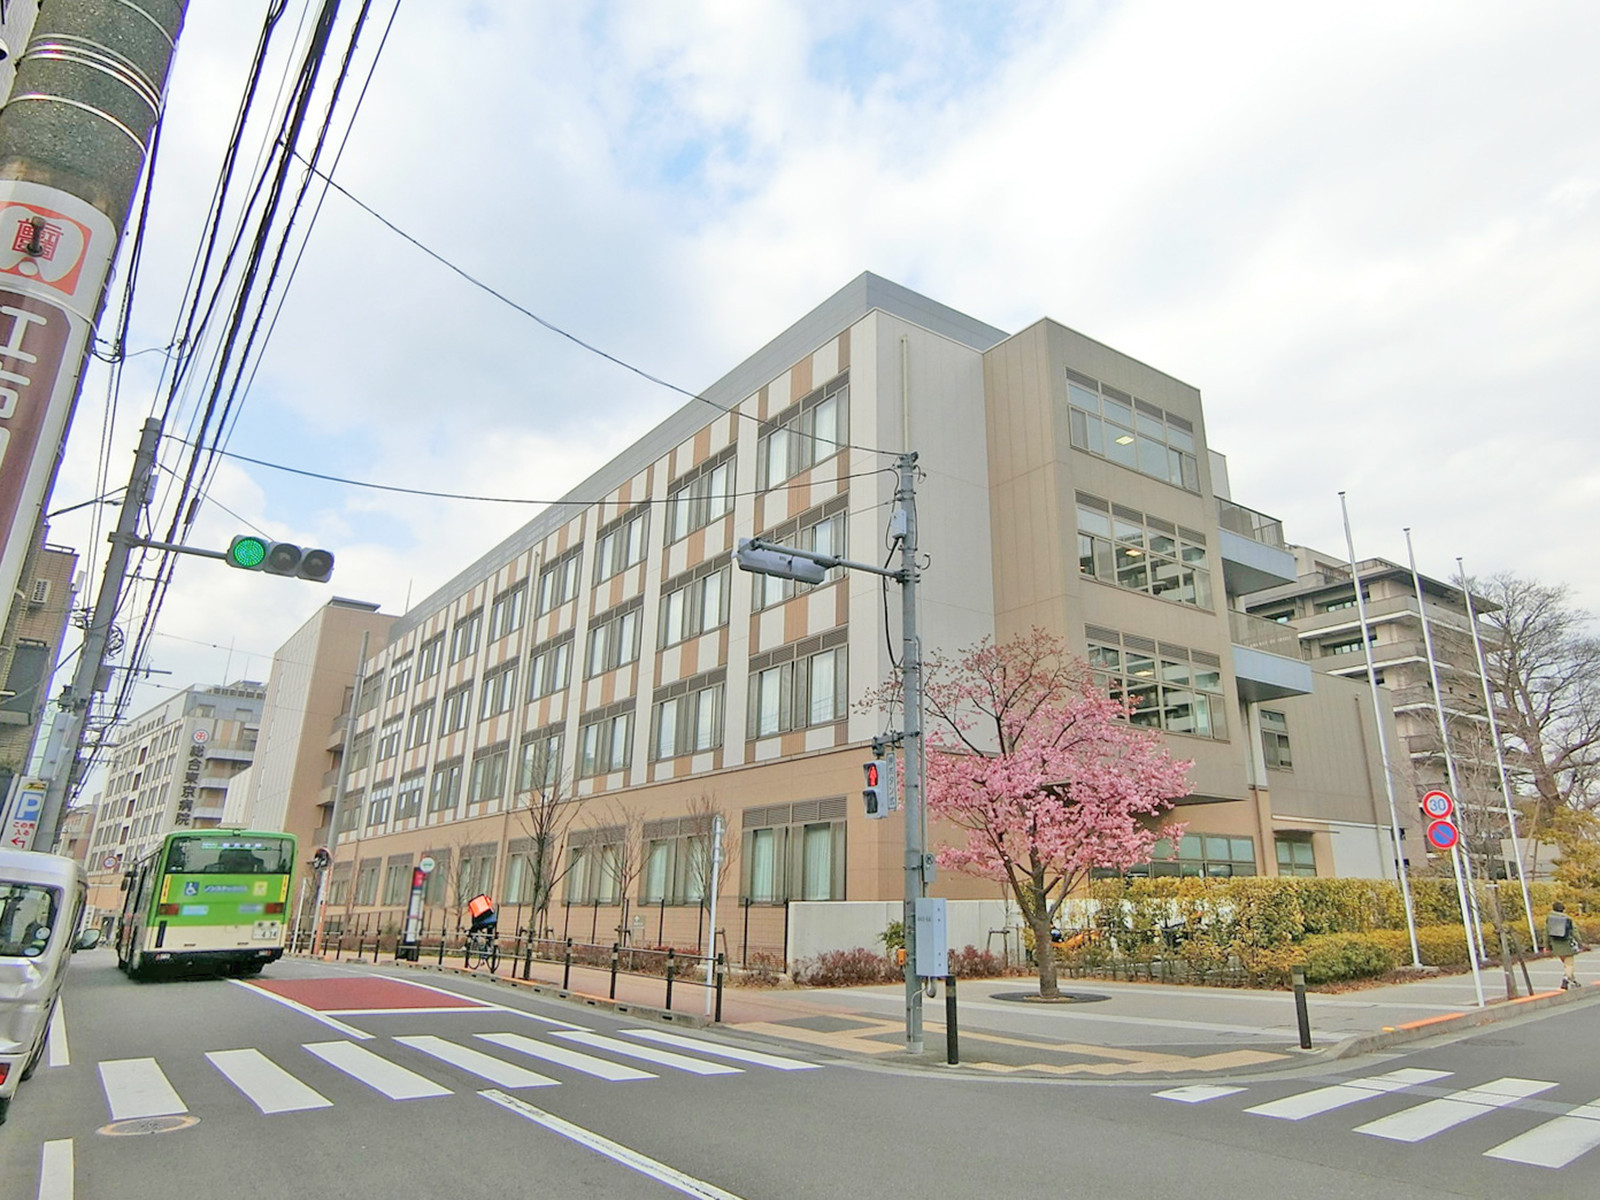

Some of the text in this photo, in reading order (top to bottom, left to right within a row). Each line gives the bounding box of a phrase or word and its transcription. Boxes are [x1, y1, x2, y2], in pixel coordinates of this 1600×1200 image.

[175, 745, 204, 826] 総合東京病院
[17, 794, 42, 818] P
[1429, 798, 1447, 812] 30
